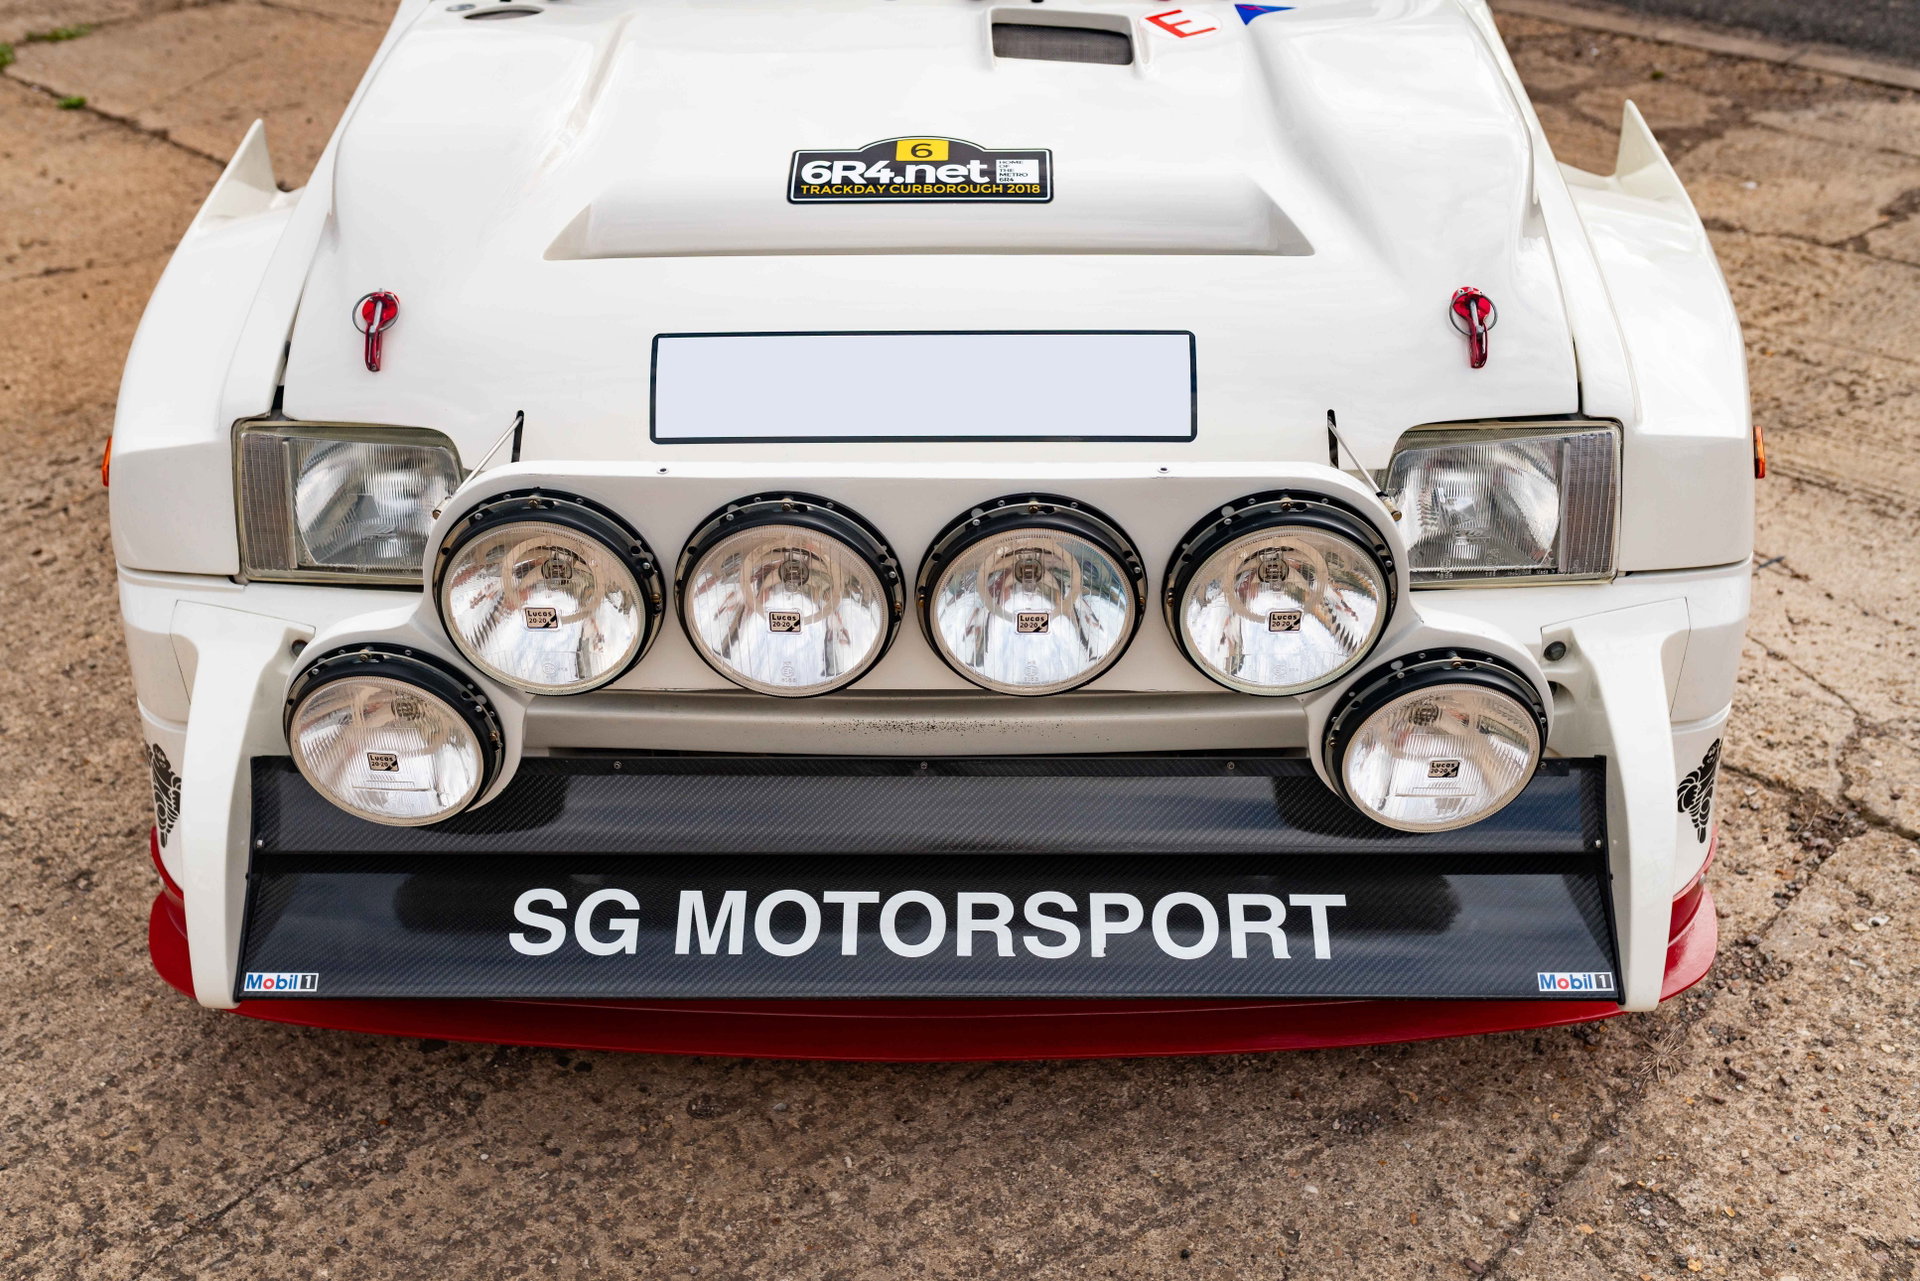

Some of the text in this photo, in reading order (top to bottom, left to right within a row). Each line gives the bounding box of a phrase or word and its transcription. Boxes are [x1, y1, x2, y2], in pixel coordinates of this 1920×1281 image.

[1145, 9, 1217, 38] E
[911, 143, 933, 158] 6
[801, 160, 991, 184] 6R4.net
[800, 184, 1041, 194] TRACKDAY CURBOROUGH 2018
[508, 888, 1347, 960] SG MOTORSPORT
[246, 974, 298, 989] Mobil
[1540, 974, 1593, 989] Mobil
